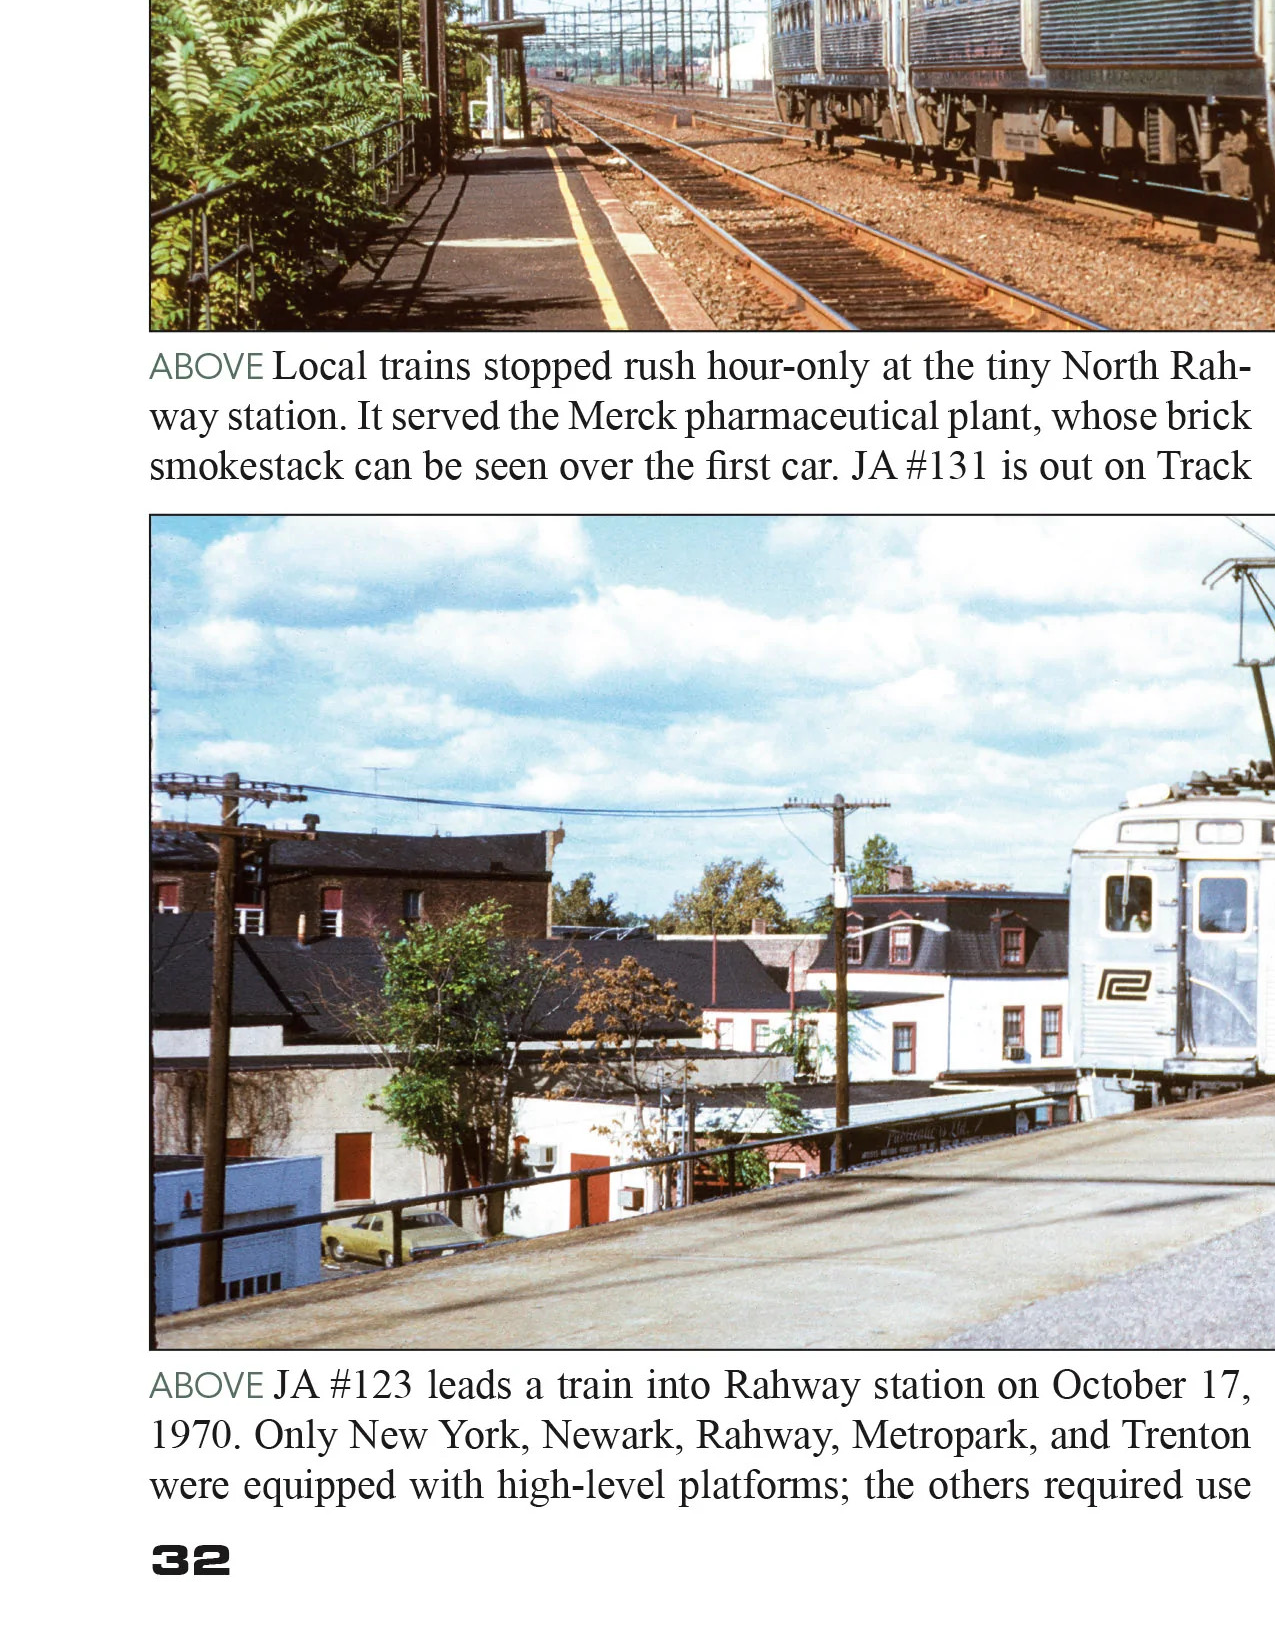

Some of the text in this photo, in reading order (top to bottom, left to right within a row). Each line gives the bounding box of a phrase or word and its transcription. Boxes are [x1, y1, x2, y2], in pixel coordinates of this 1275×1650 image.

[149, 350, 1251, 388] ABOVE Local trains stopped rush hour-only at the tiny North Rah-
[149, 400, 1252, 438] way station. It served the Merck pharmaceutical plant, whose brick
[151, 450, 1252, 480] smokestack can be seen over the first car. JA #131 is out on Track
[149, 1369, 1249, 1407] ABOVE JA #123 leads a train into Rahway station on October 17,
[154, 1419, 1251, 1457] 1970. Only New York, Newark, Rahway, Metropark, and Trenton
[149, 1469, 1251, 1507] were equipped with high-level platforms; the others required use
[152, 1545, 230, 1575] 32
